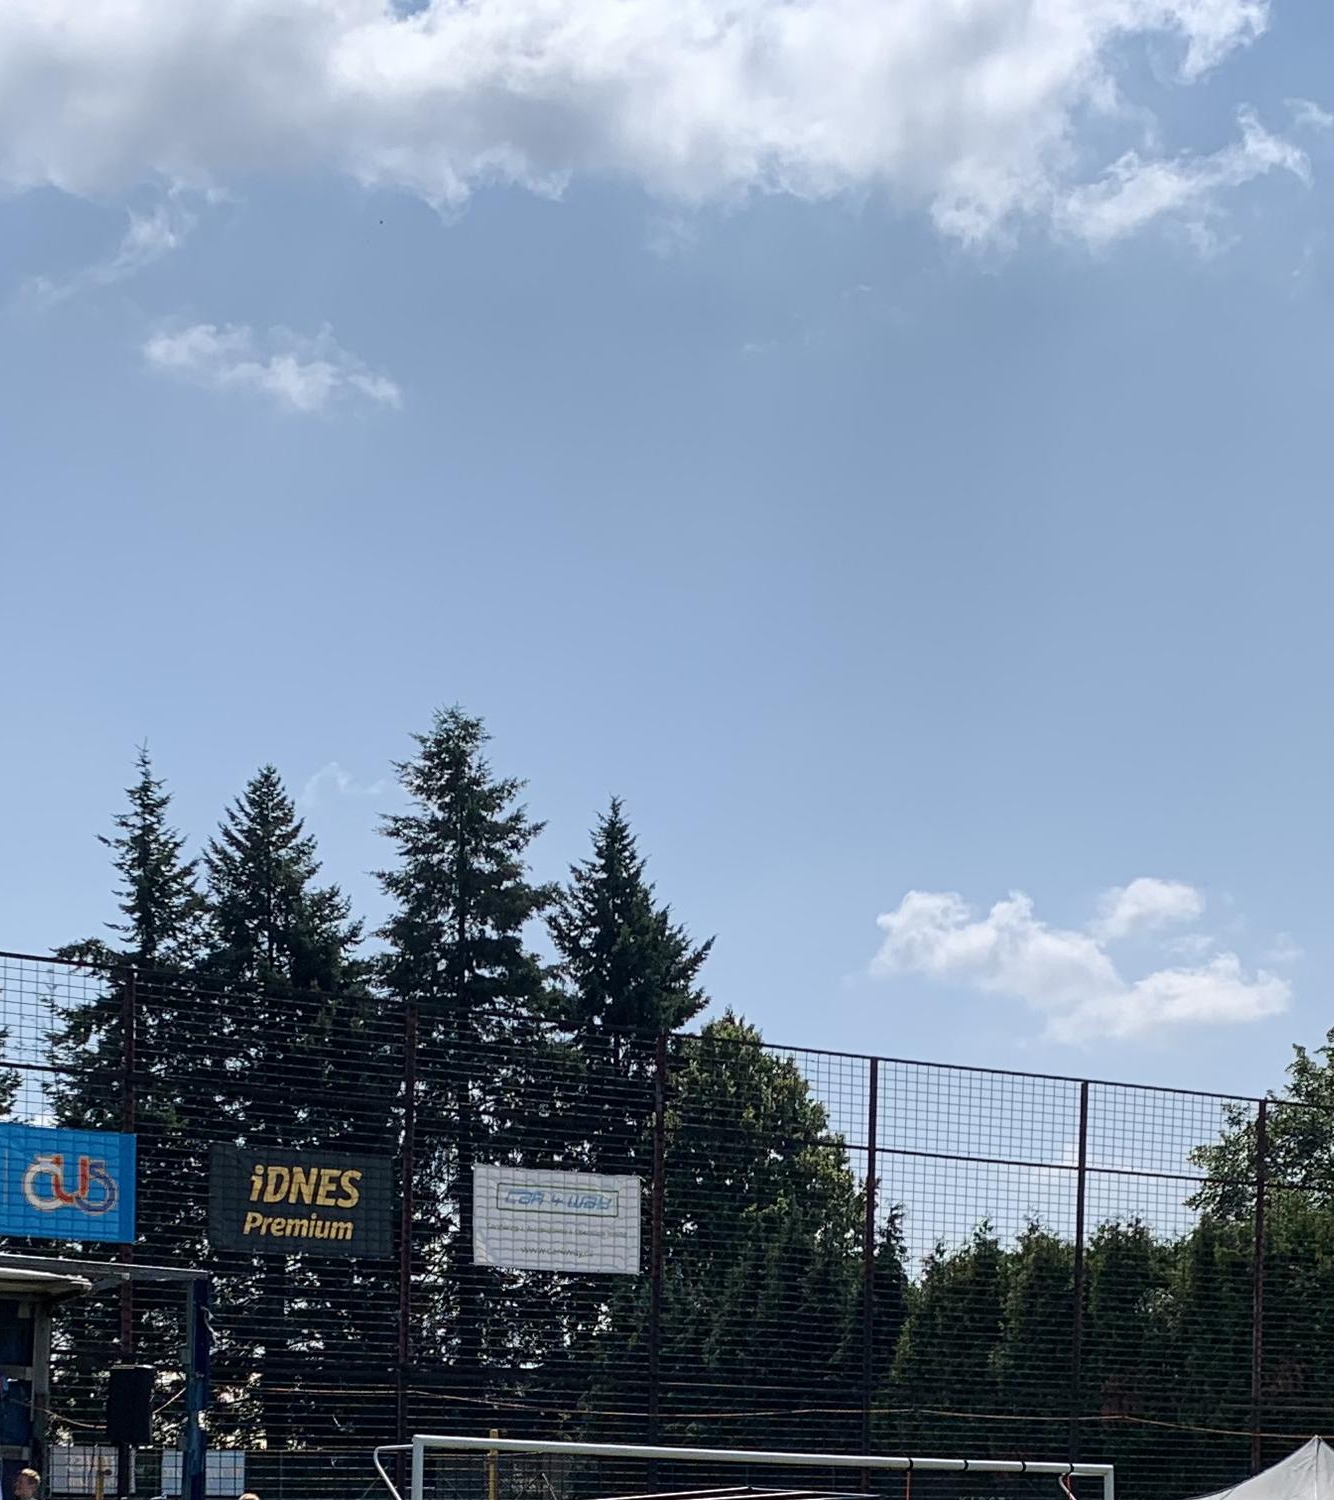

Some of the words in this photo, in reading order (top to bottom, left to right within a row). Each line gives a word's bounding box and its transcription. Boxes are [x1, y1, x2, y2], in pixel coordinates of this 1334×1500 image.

[249, 1164, 363, 1208] iDNES
[550, 1191, 565, 1207] 4
[243, 1211, 354, 1240] Premium
